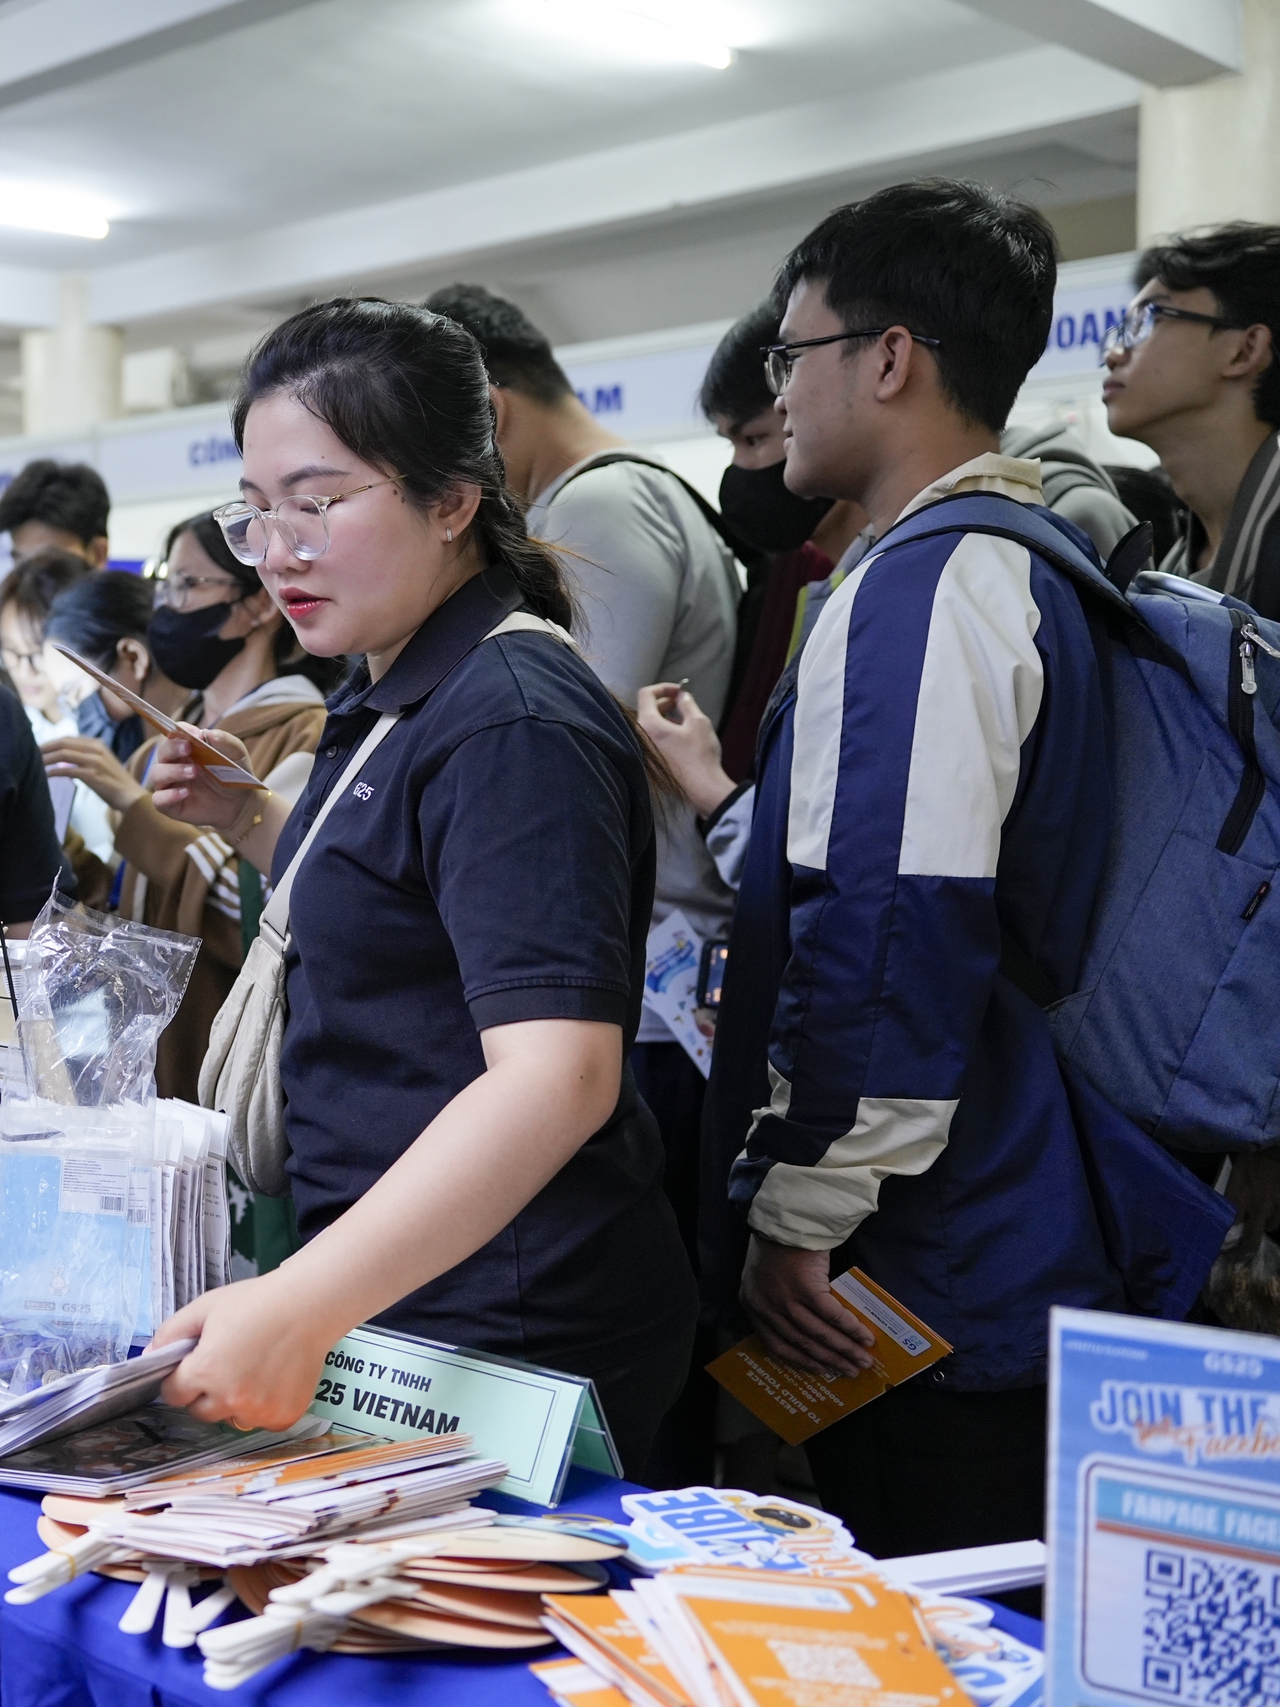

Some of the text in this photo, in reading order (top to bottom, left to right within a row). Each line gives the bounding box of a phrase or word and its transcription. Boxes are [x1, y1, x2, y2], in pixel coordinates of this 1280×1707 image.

[61, 1302, 92, 1314] GS25
[869, 1311, 889, 1327] VIETNAM
[901, 1337, 918, 1352] GS
[908, 1334, 924, 1347] 25
[324, 1350, 433, 1393] CÔNG TY TNHH
[736, 1349, 821, 1425] TO BUILD YOURSELF
[745, 1369, 798, 1415] BEST PLACE
[796, 1385, 818, 1404] 400+
[801, 1380, 827, 1402] 5000+
[814, 1381, 845, 1408] 60000+
[314, 1379, 461, 1435] 25 VIETNAM
[1097, 1385, 1183, 1430] JOIN
[1121, 1490, 1219, 1534] FANPAGE
